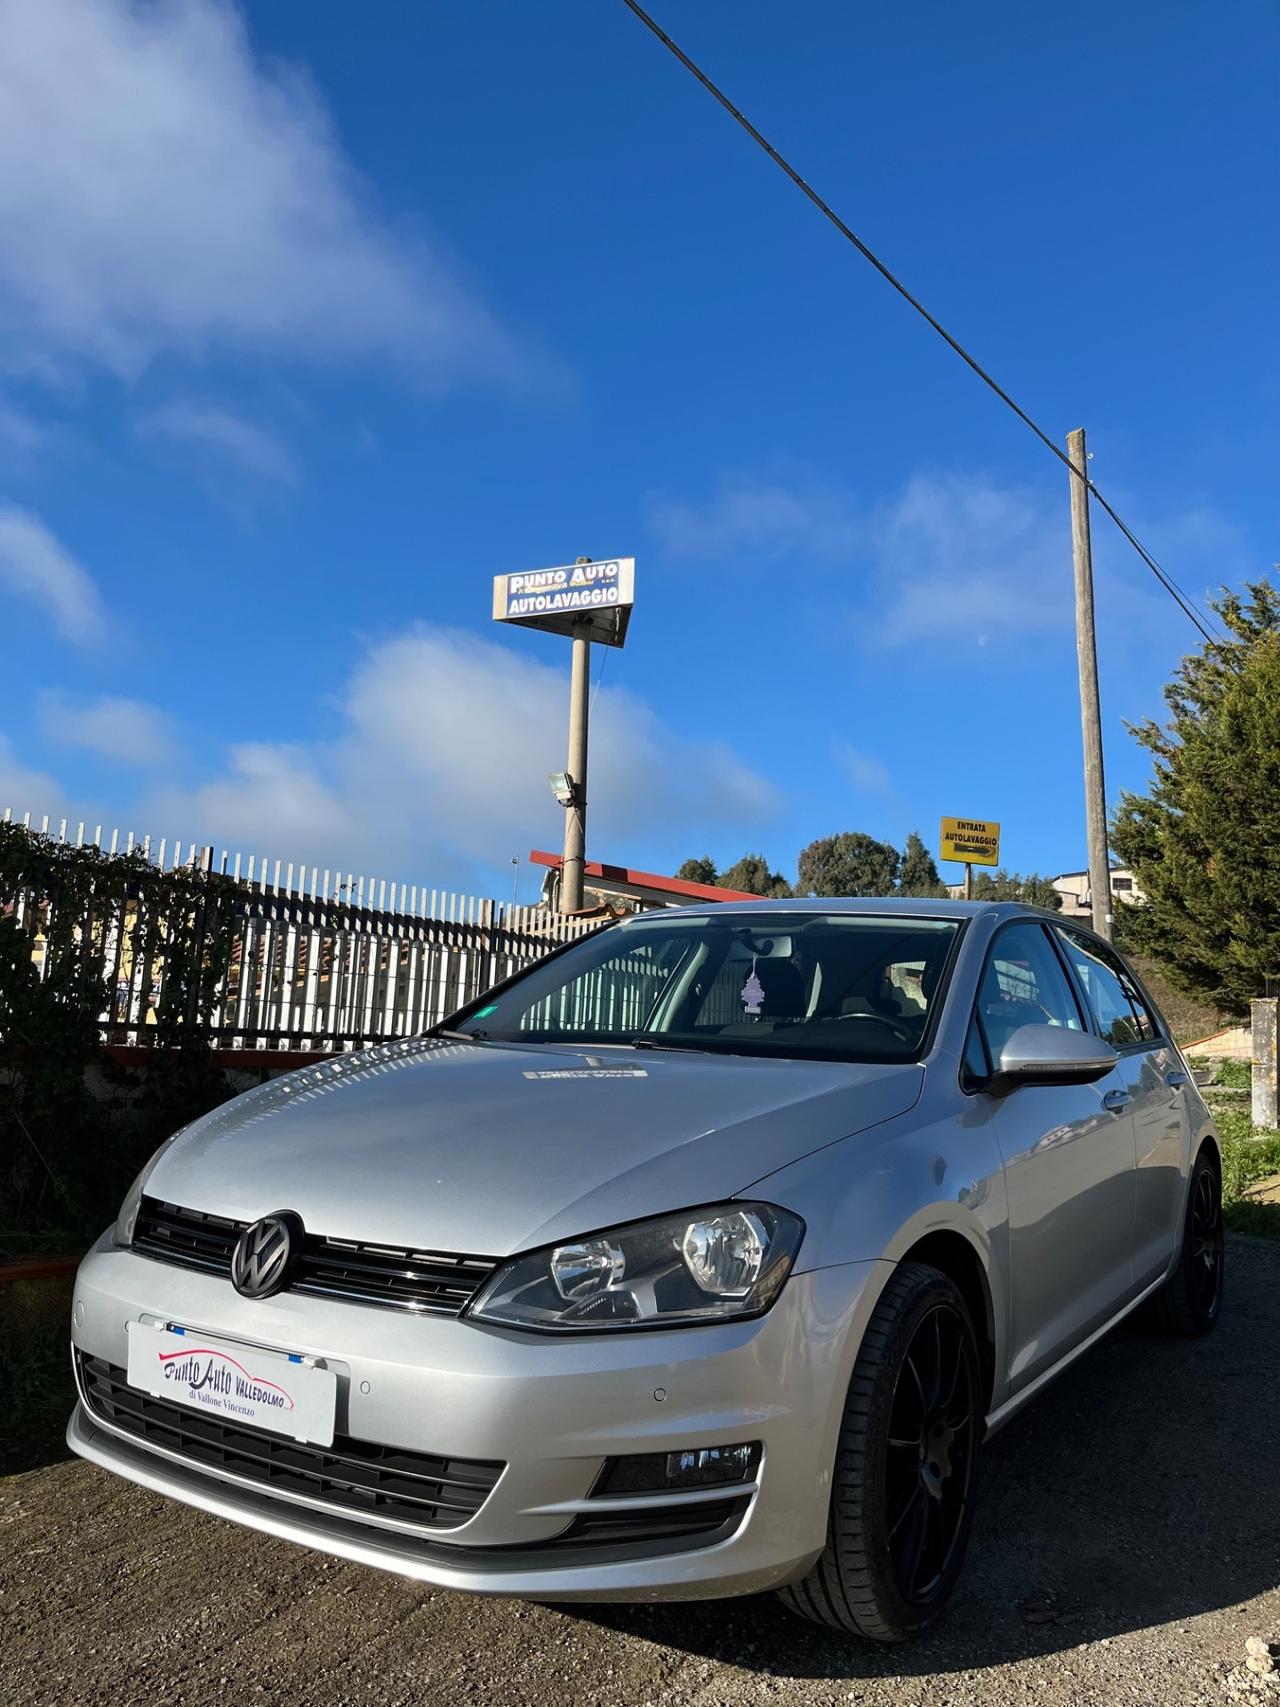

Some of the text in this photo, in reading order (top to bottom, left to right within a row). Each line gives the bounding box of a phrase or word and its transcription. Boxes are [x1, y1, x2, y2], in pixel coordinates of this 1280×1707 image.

[510, 564, 618, 593] PUNTO AUTO
[509, 587, 618, 614] AUTOLAVAGGIO
[945, 832, 997, 846] AUTOLAVAGGIO
[957, 821, 986, 832] ENTRATA
[164, 1356, 285, 1408] Punto Auto VALLEDOLMO
[189, 1390, 255, 1416] di Vallone Vincenzo
